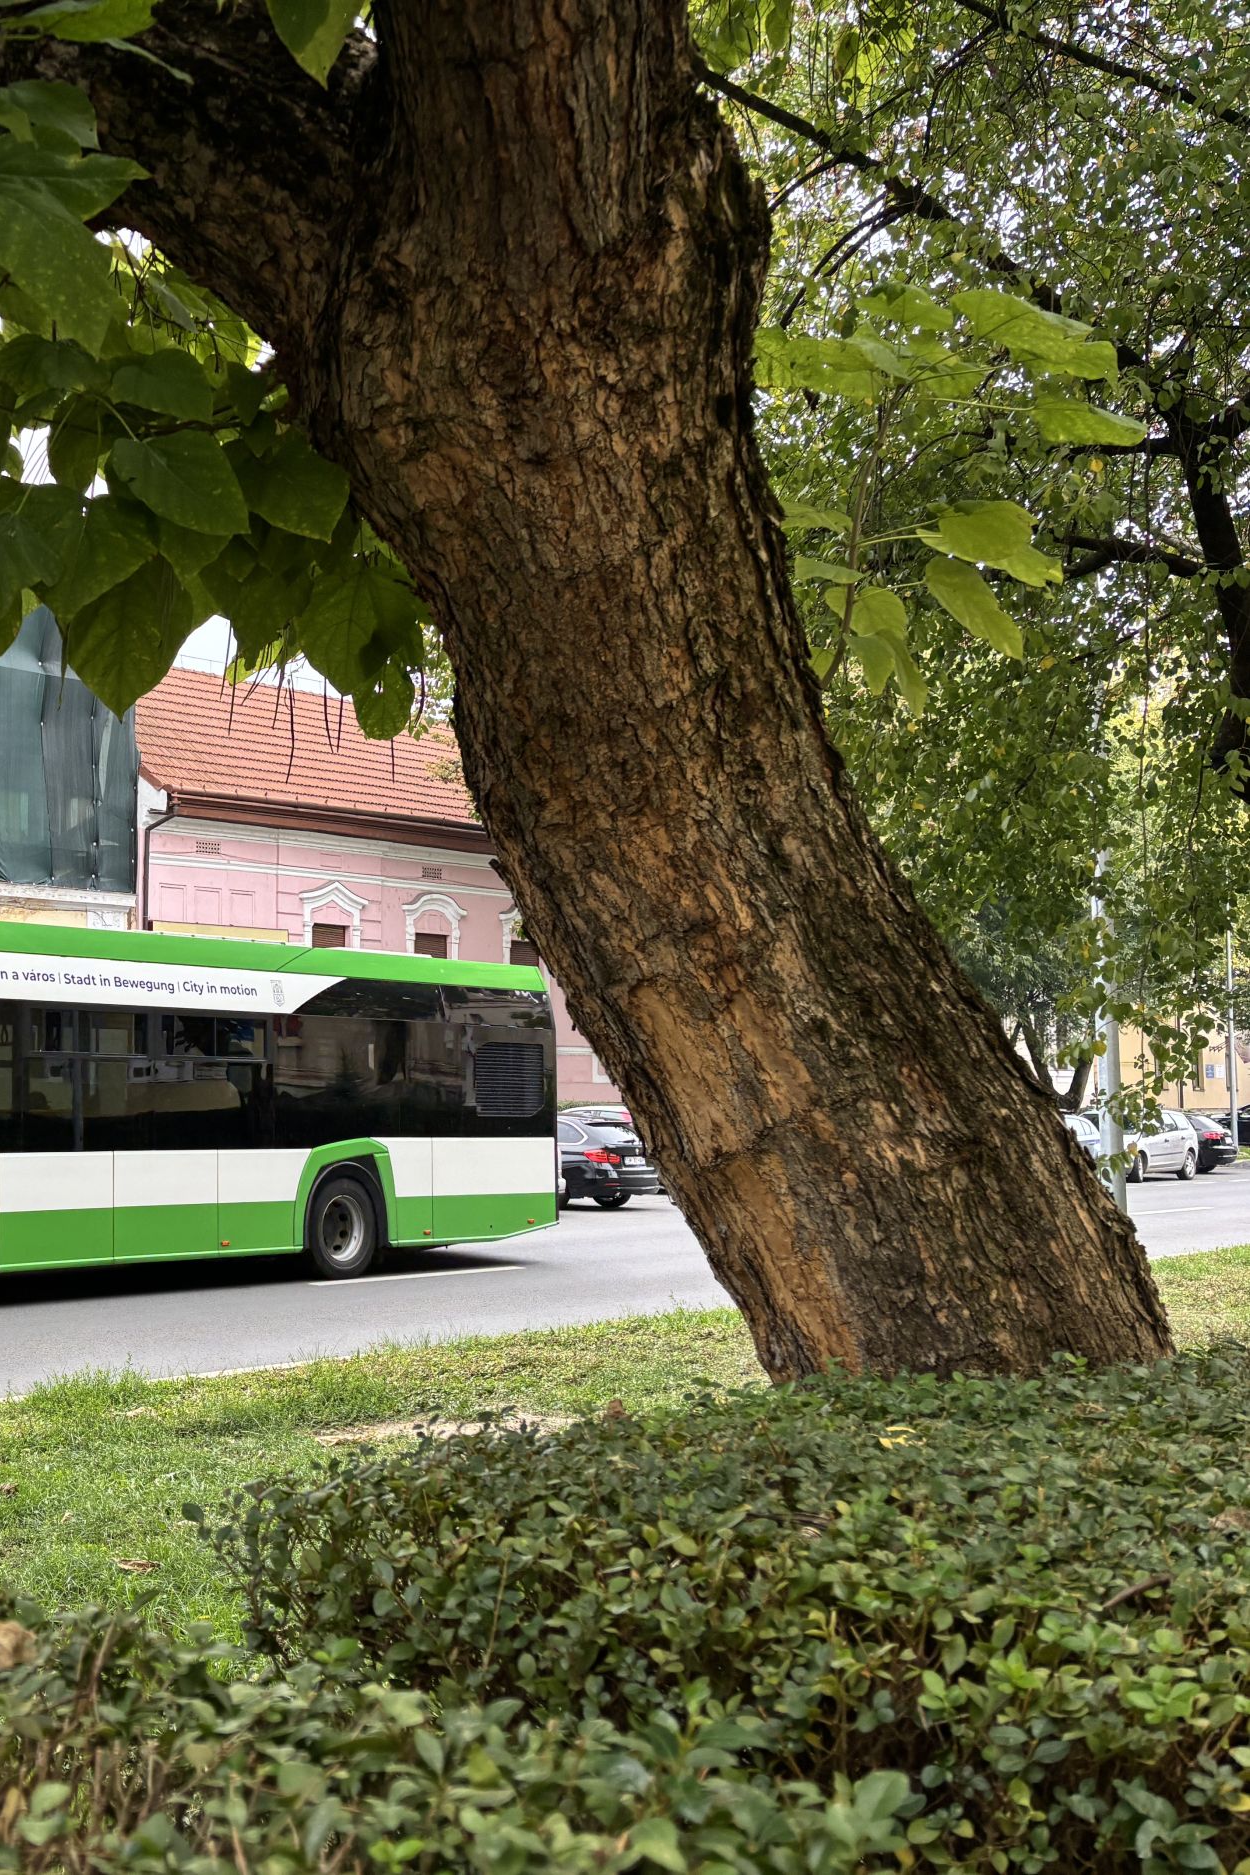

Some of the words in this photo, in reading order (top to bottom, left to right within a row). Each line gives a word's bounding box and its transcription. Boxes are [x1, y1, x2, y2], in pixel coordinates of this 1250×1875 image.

[12, 969, 20, 980] a
[21, 969, 56, 983] város
[63, 973, 97, 987] Stadt
[99, 975, 111, 987] in
[113, 976, 175, 994] Bewegung
[182, 981, 204, 995] City
[206, 982, 217, 994] in
[220, 984, 258, 997] motion
